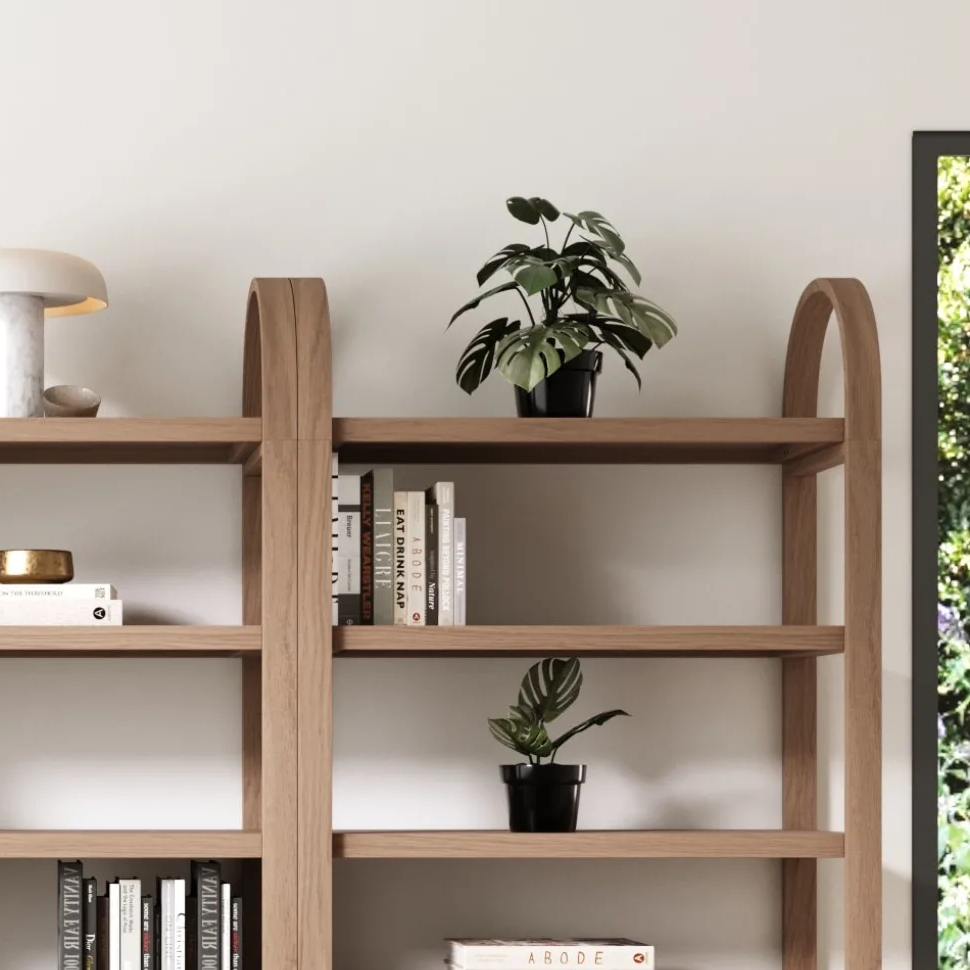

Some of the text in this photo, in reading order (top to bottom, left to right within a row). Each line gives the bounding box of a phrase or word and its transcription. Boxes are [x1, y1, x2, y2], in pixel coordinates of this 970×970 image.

[442, 509, 450, 543] PAINTING
[362, 483, 371, 619] KELLY WEARSTLER
[375, 508, 392, 589] LIAIGRE
[396, 509, 405, 609] EAT DRINK NAP
[412, 536, 422, 592] ABODE
[442, 545, 450, 576] BEYOND
[456, 542, 464, 594] MINIMAL
[428, 582, 436, 610] Nature
[442, 577, 450, 611] POLLOCK
[86, 934, 95, 950] Dior
[527, 951, 604, 965] ABODE
